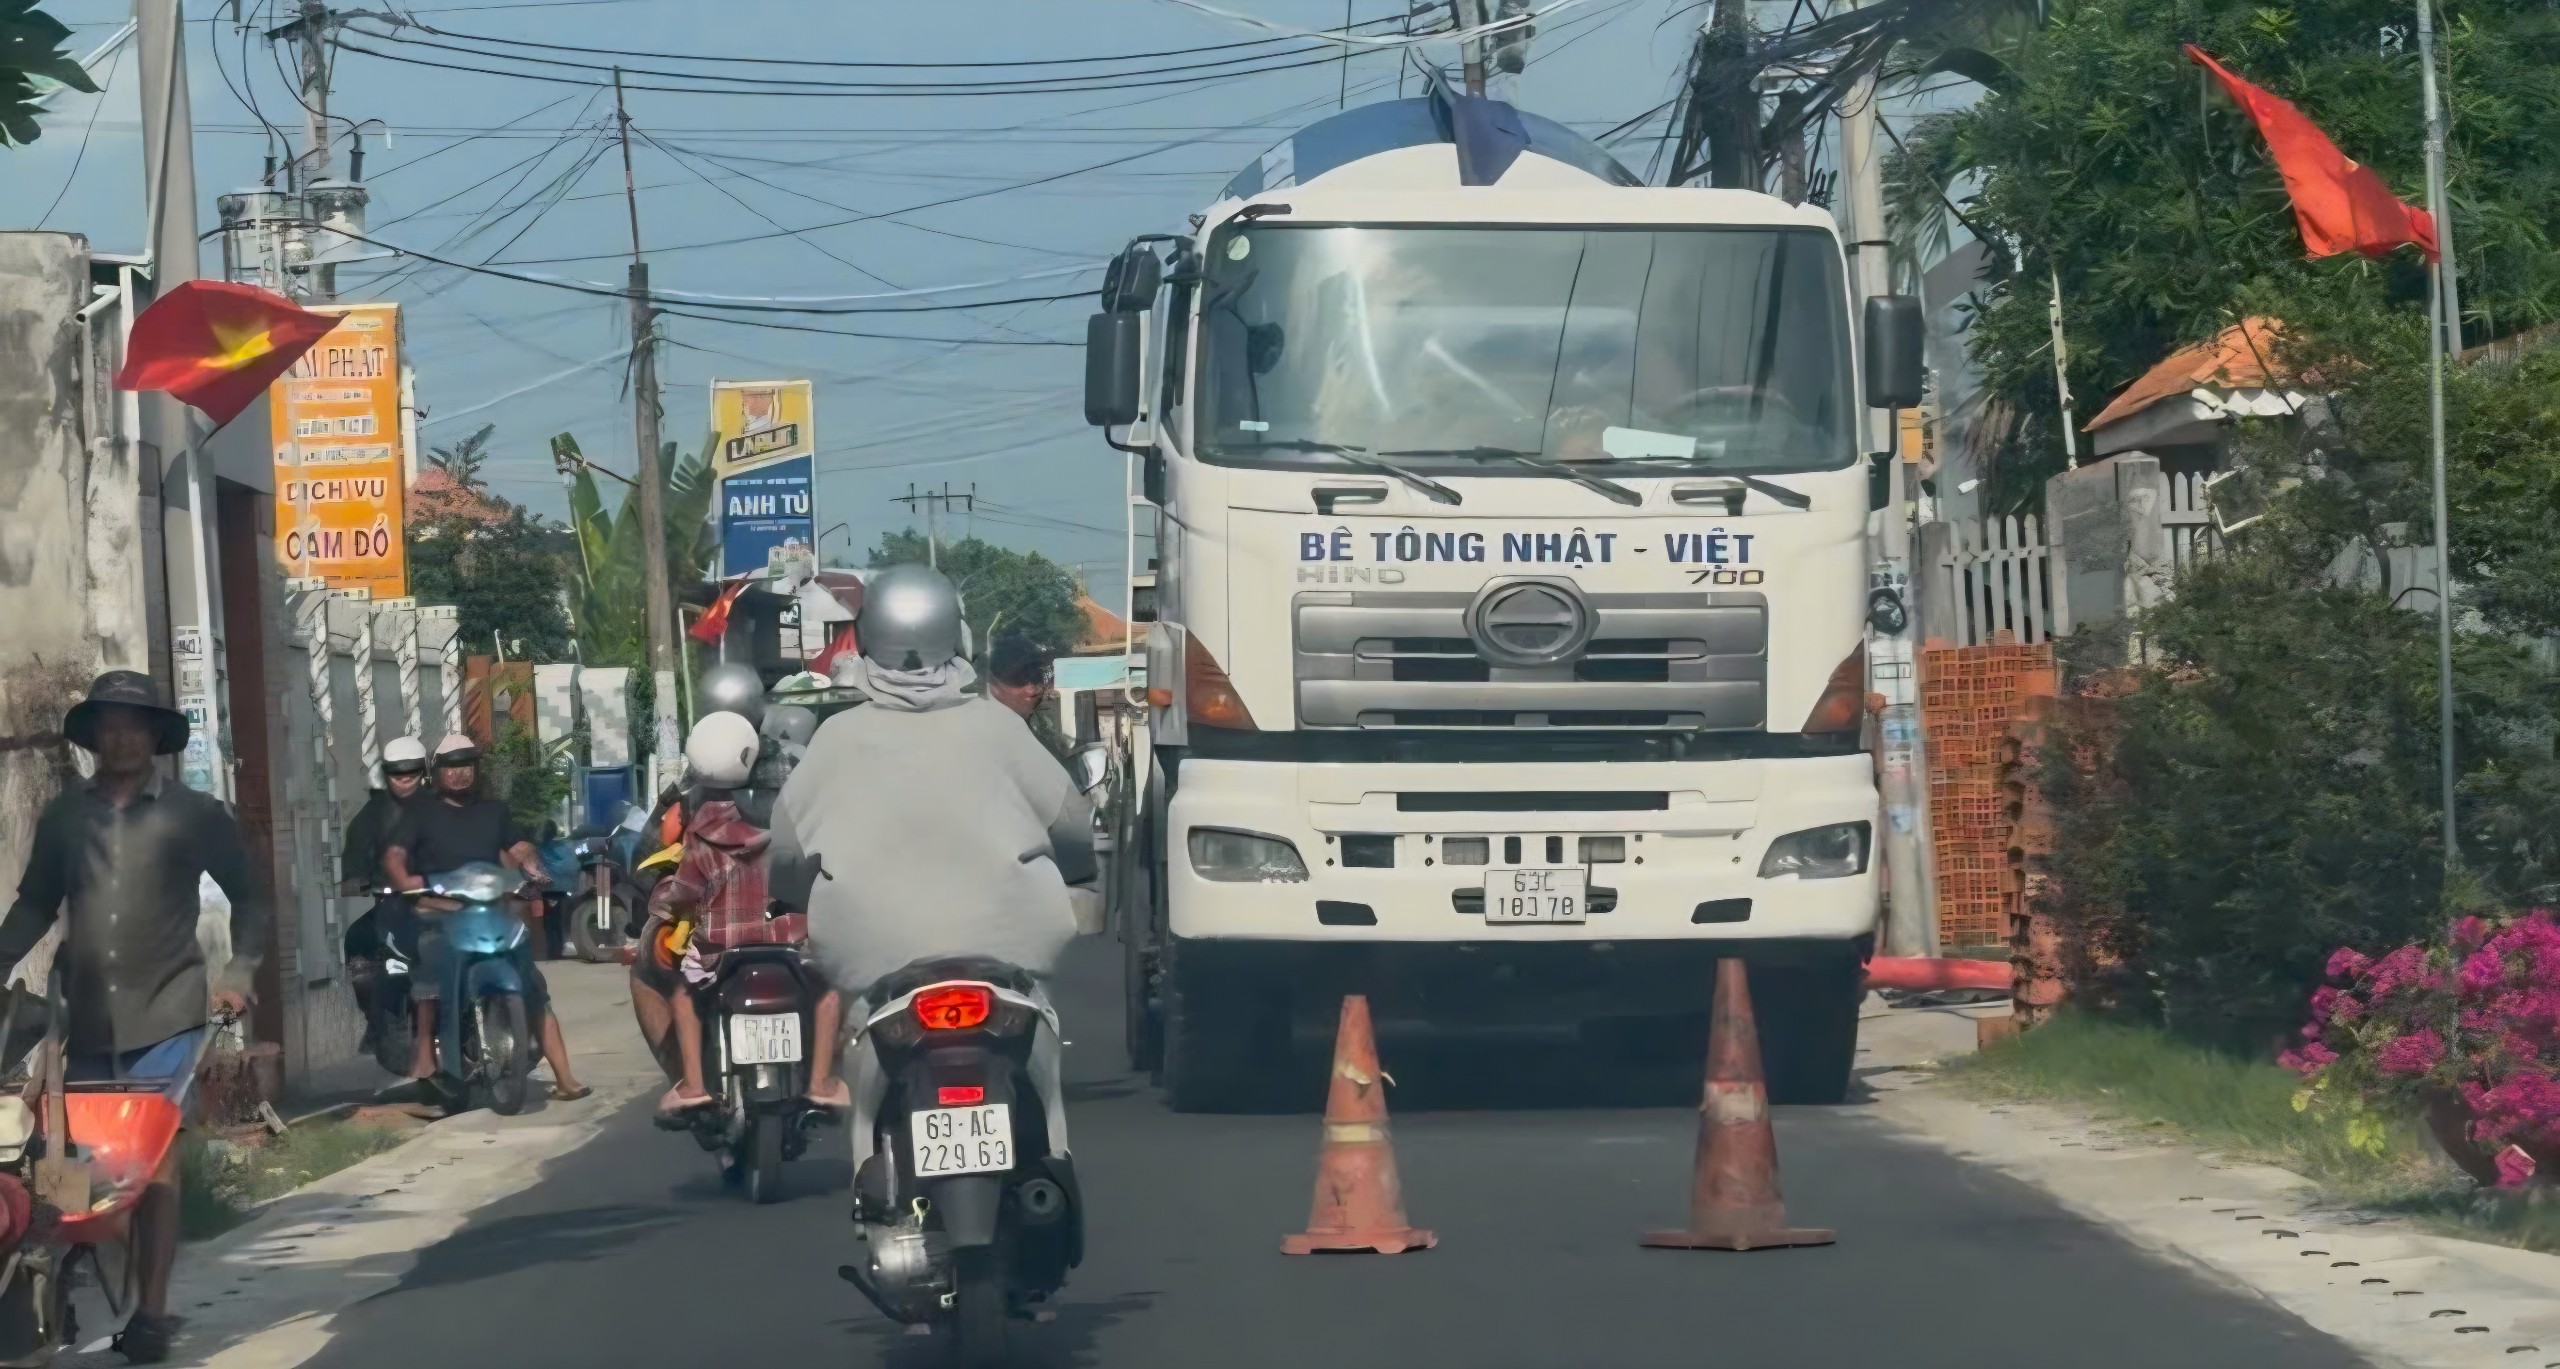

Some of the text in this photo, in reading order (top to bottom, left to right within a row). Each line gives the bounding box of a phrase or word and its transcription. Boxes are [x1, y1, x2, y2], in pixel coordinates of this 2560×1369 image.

[728, 495, 776, 516] ANH
[1300, 525, 1354, 562] BÊ
[1370, 525, 1485, 562] TÔNG
[1502, 526, 1618, 569] NHẬT
[1664, 526, 1755, 570] VIỆT
[1685, 569, 1765, 585] 700
[920, 1140, 1007, 1172] 229.63
